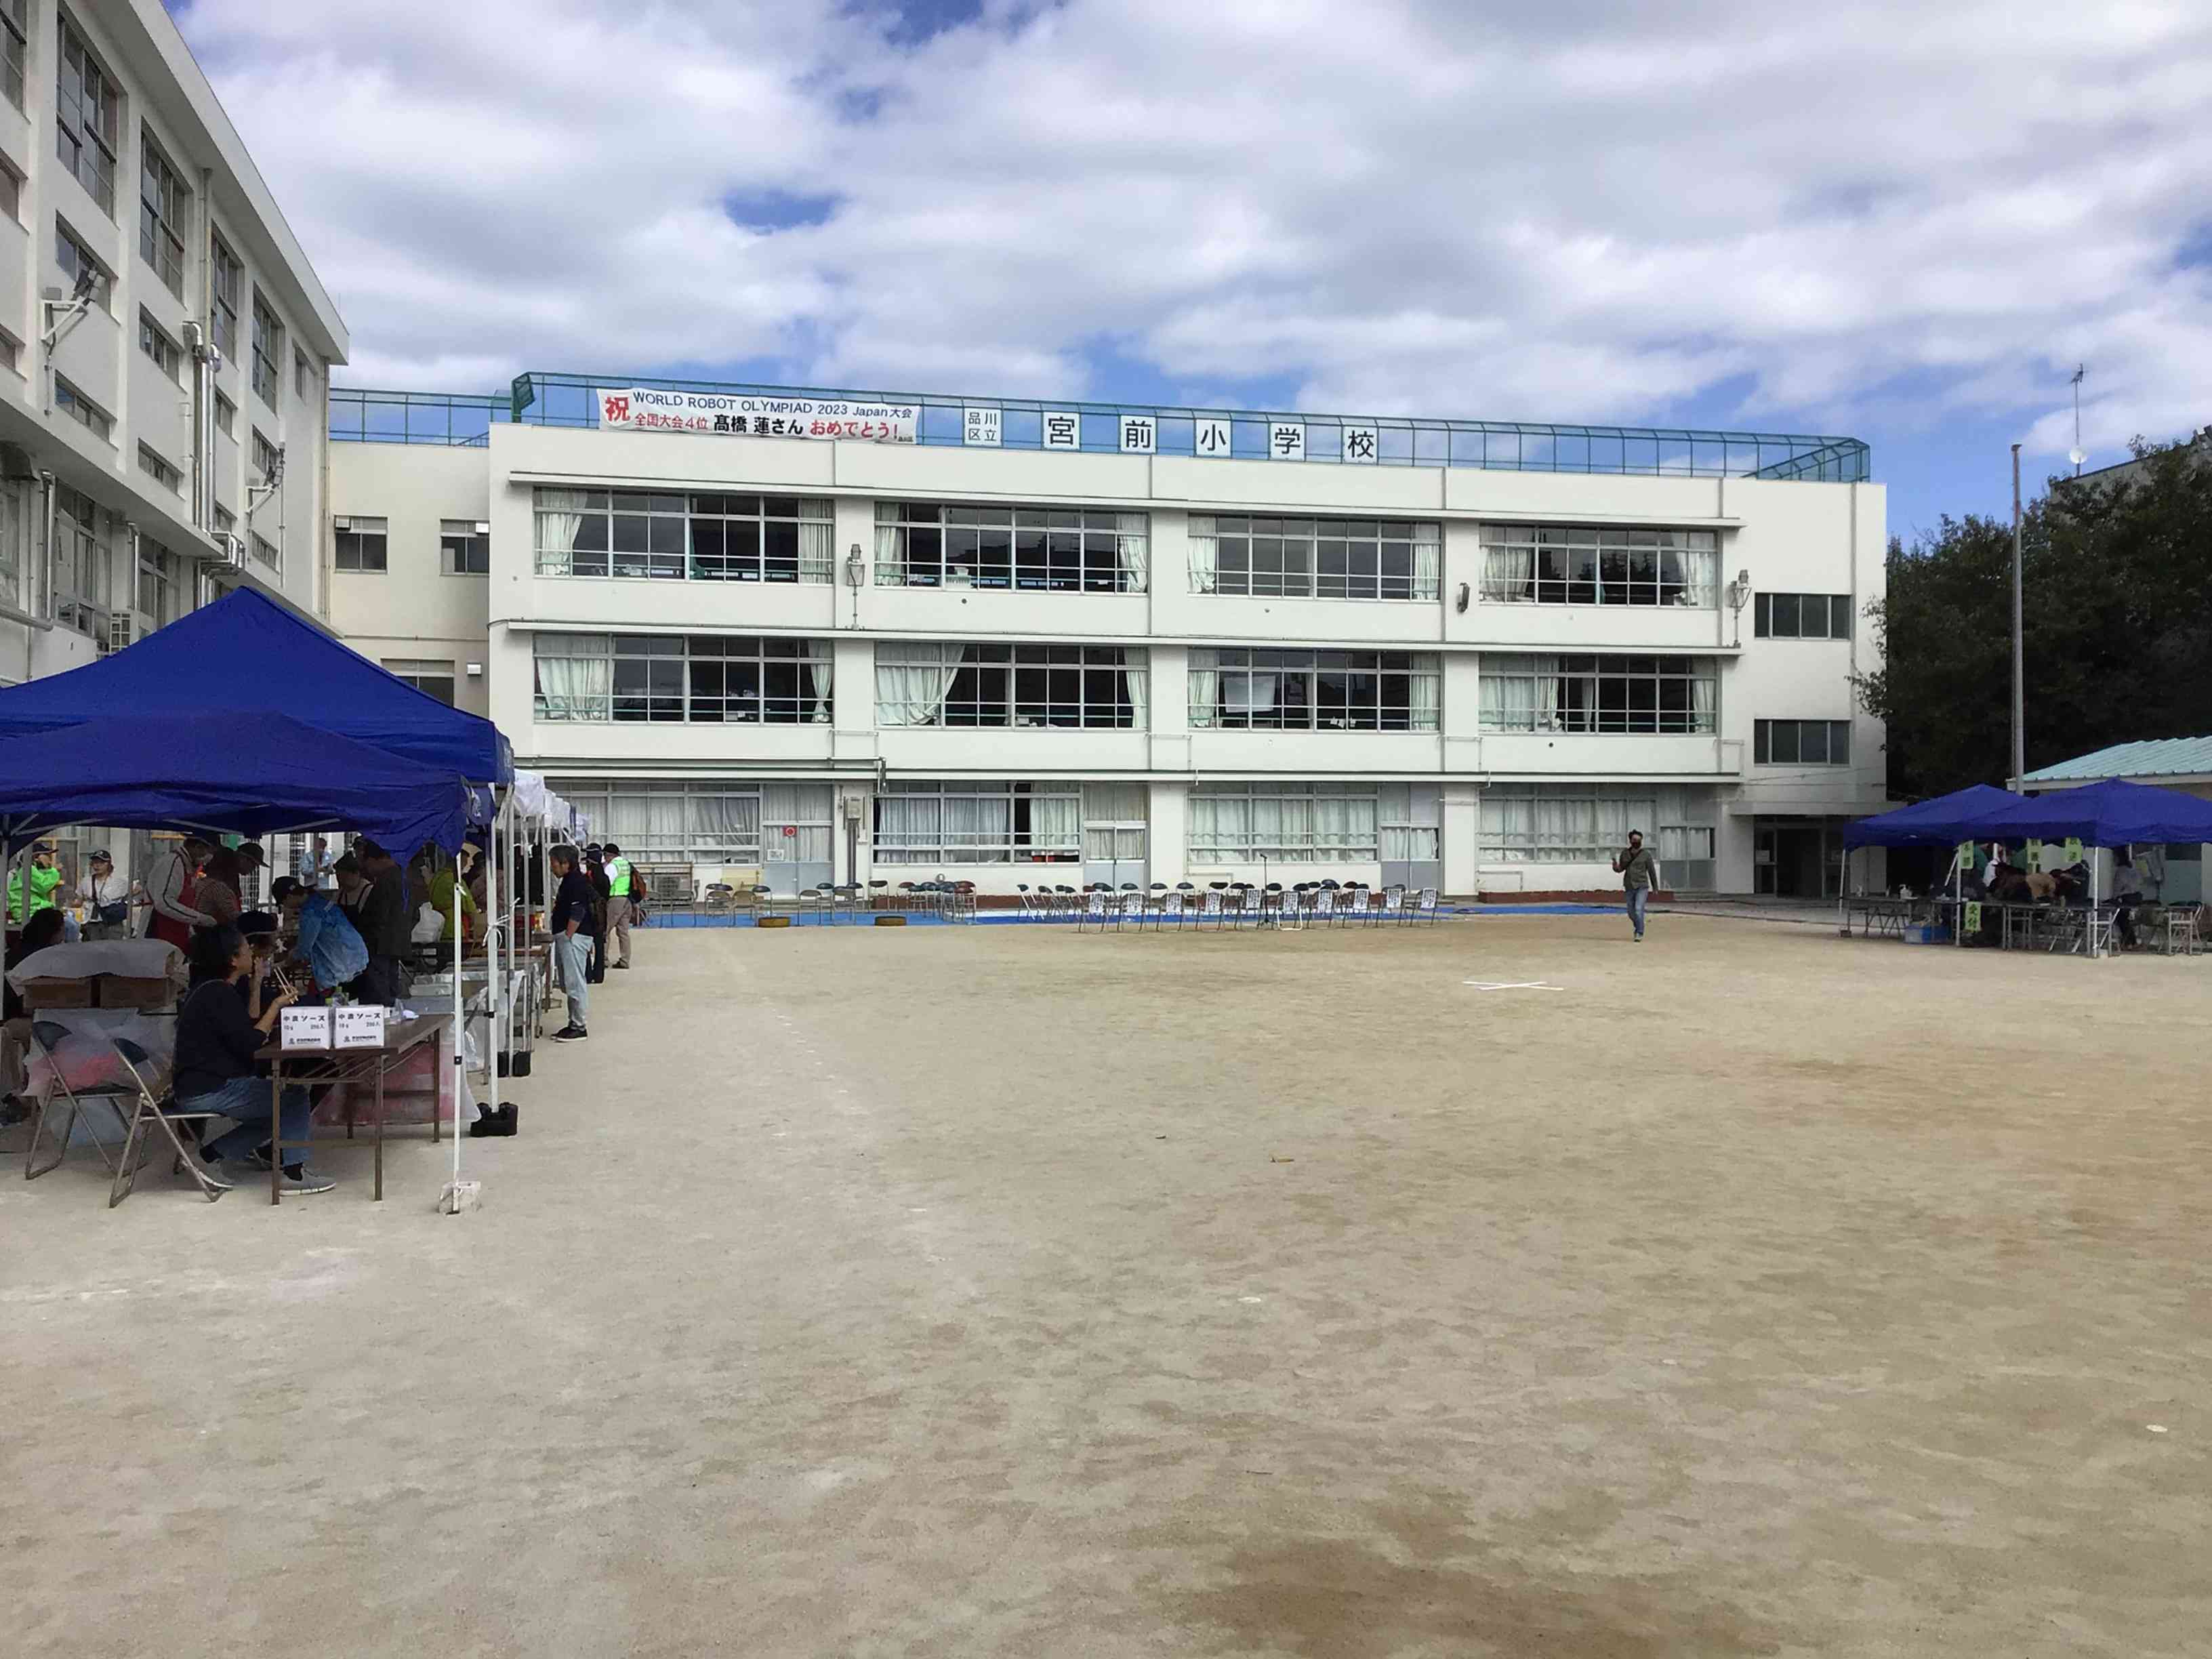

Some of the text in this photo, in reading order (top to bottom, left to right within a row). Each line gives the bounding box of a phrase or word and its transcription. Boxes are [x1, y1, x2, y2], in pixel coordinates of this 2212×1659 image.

[605, 396, 631, 422] 祝
[633, 392, 682, 406] WORLD
[689, 397, 736, 410] ROBOT
[741, 401, 812, 413] OLYMPIAD
[817, 404, 847, 415] 2023
[968, 412, 997, 426] 品川
[968, 428, 997, 442] 区立
